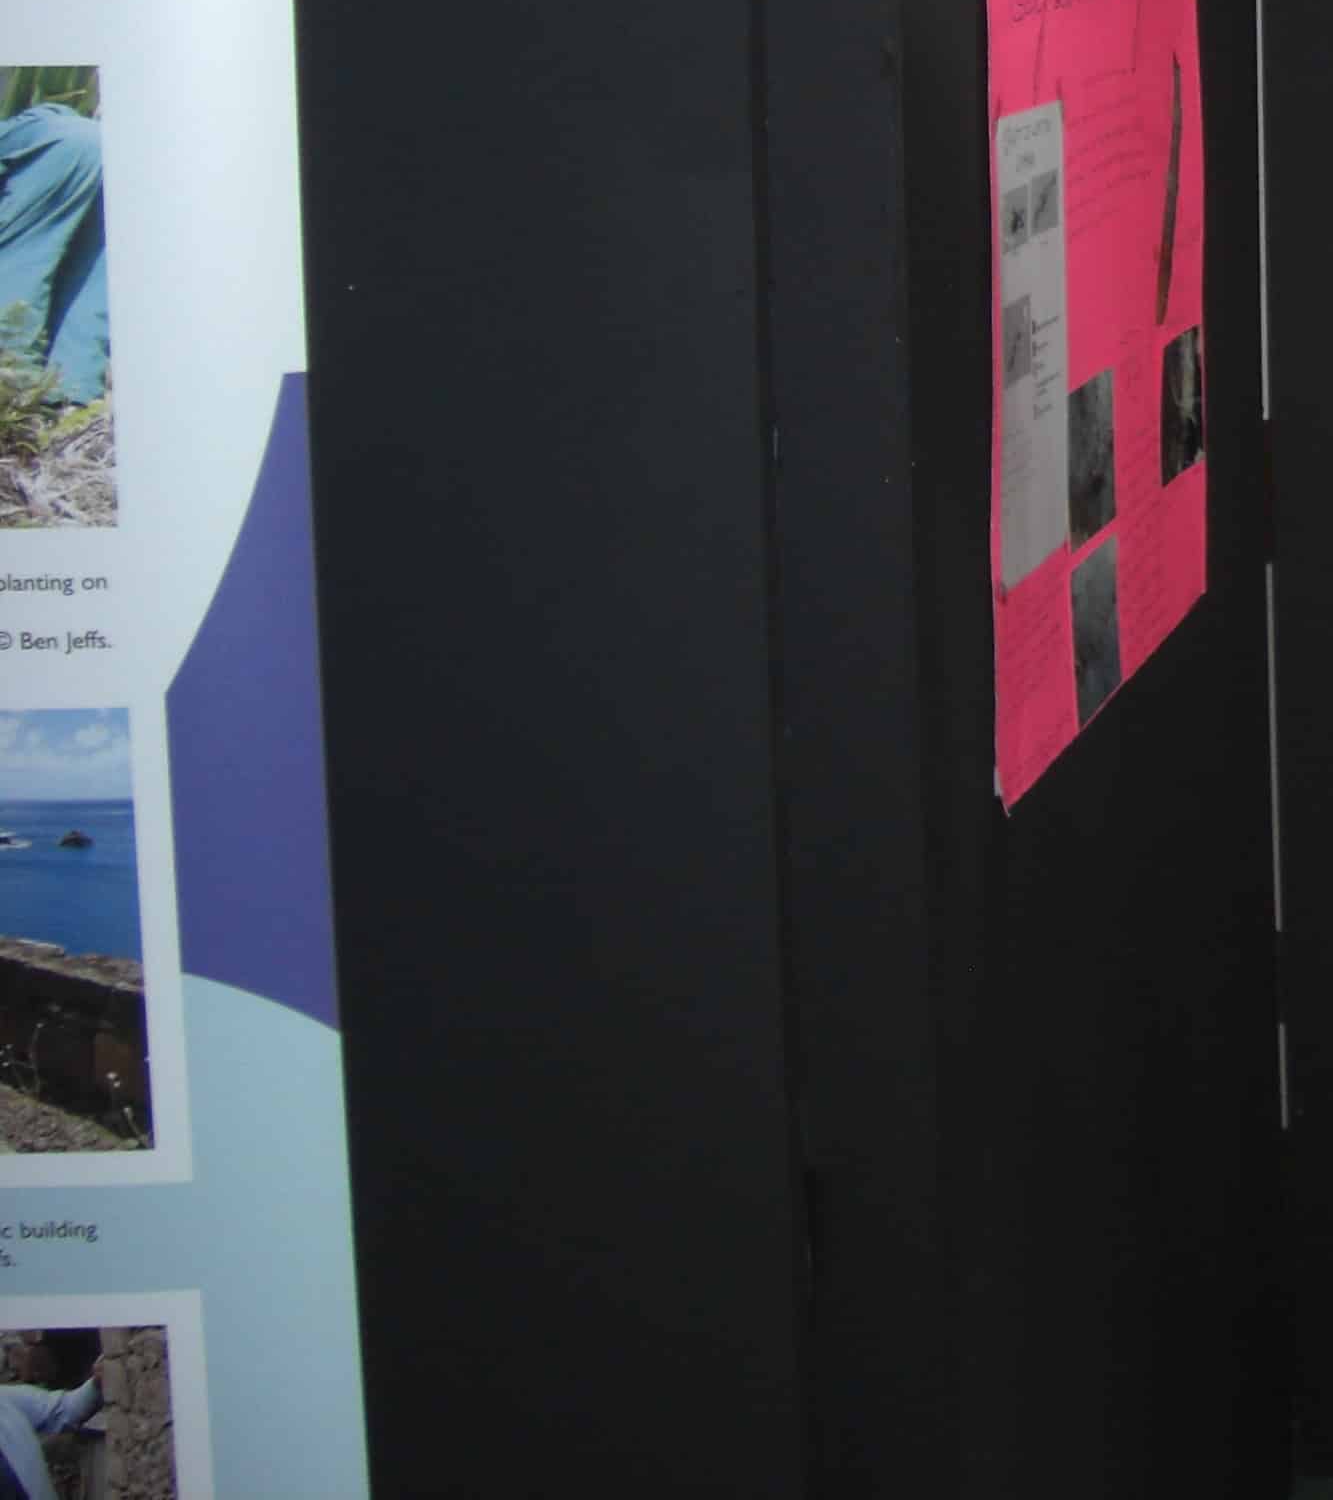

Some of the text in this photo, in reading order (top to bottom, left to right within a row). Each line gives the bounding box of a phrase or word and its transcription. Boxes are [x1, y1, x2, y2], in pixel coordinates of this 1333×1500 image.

[81, 576, 109, 591] on
[19, 629, 114, 656] Ben Jeffs.
[19, 1220, 99, 1243] building
